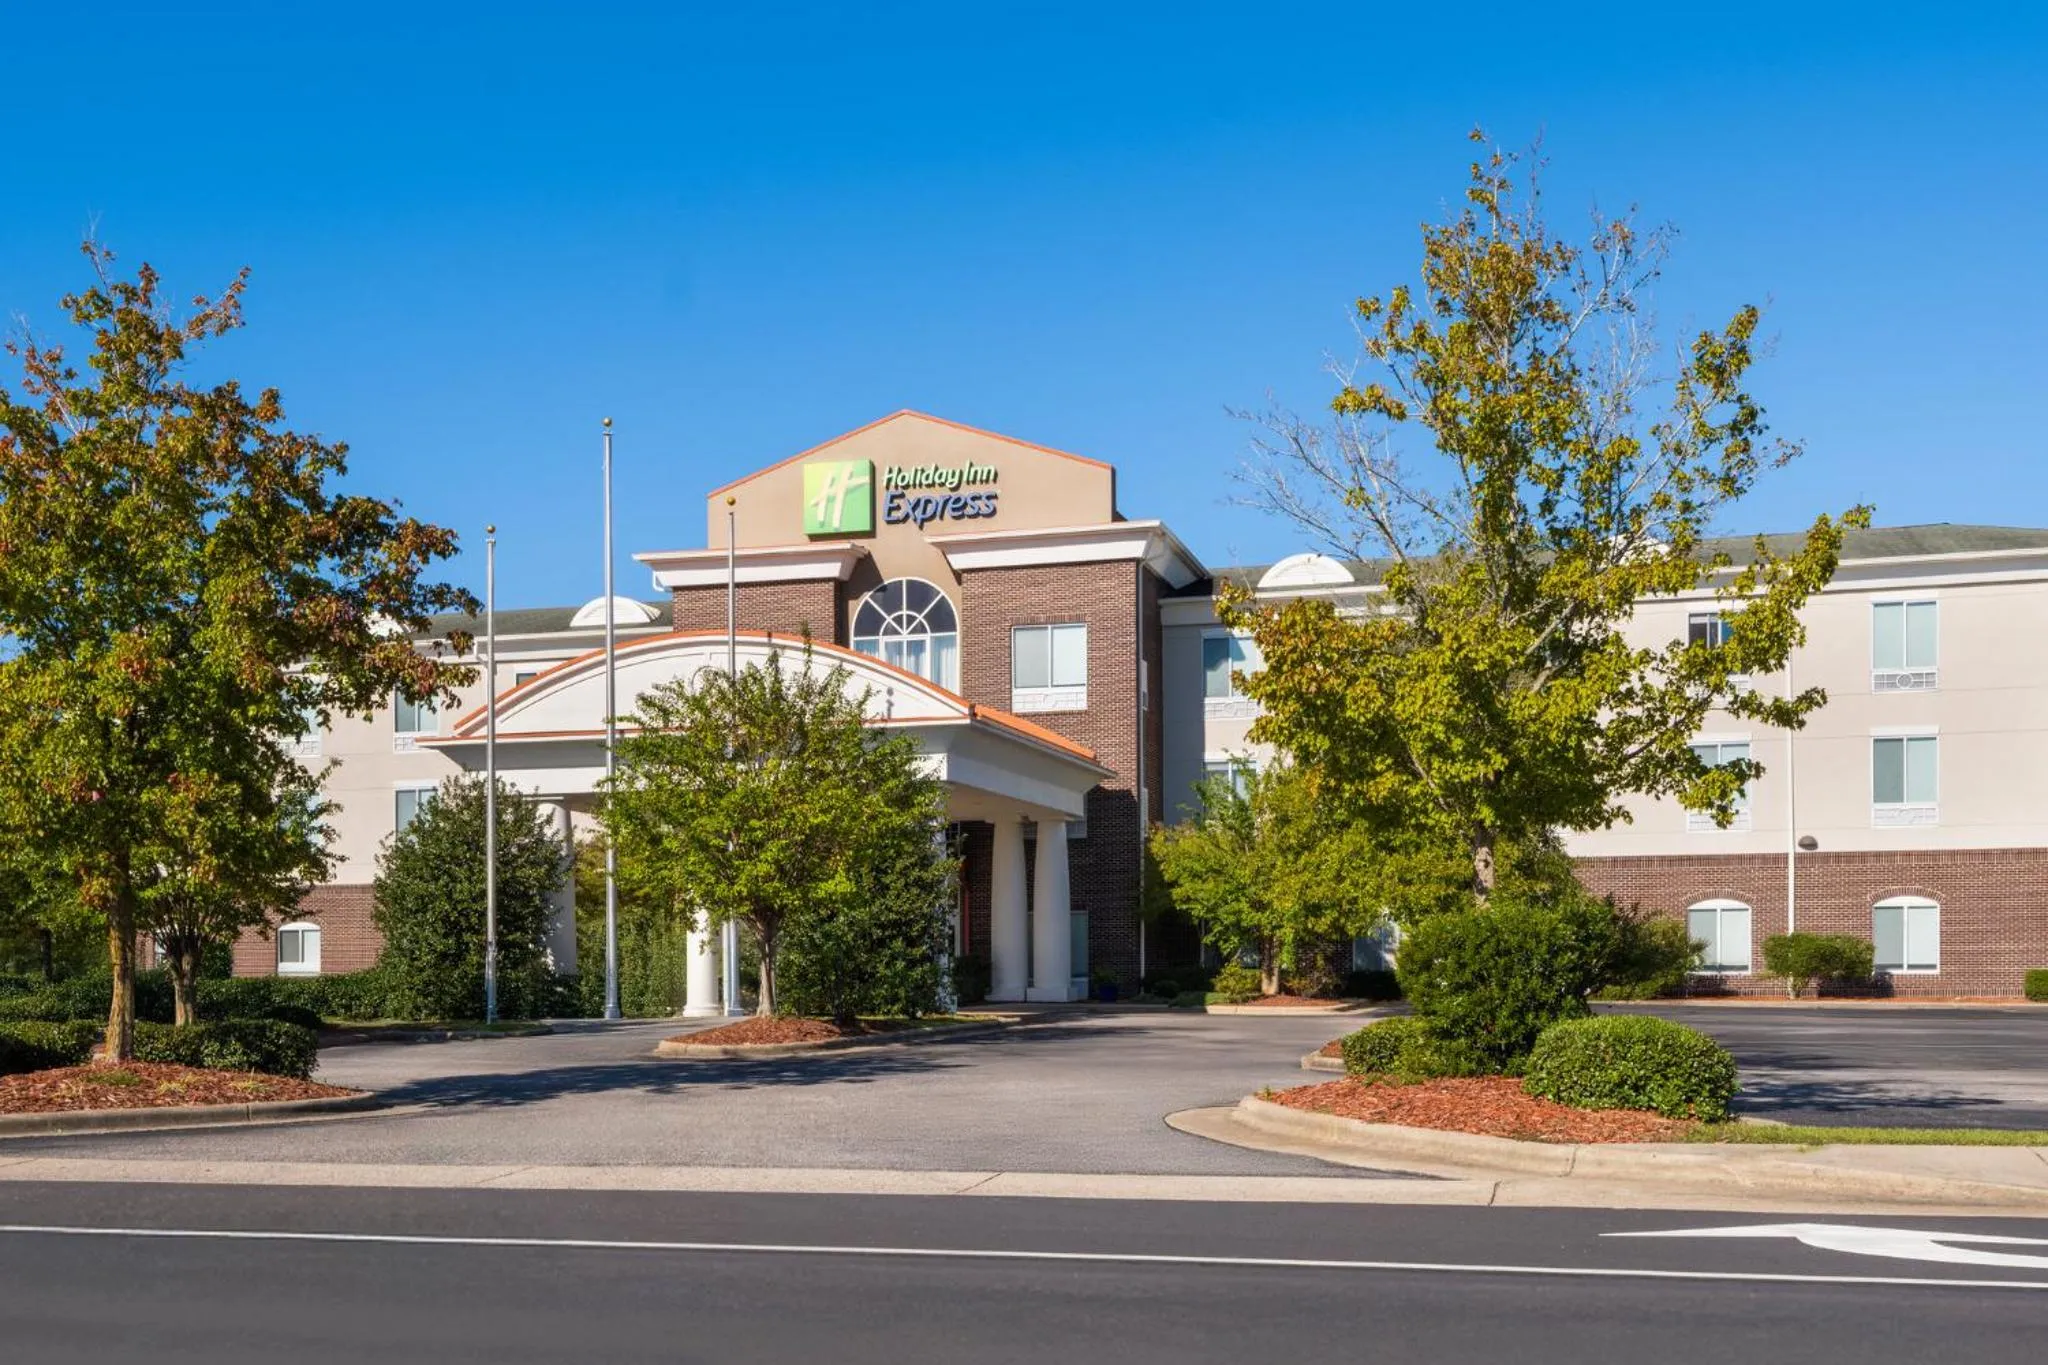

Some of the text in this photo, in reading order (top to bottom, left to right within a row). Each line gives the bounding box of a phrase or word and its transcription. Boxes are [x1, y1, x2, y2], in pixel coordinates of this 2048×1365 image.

[883, 459, 998, 490] Holiday Inn
[883, 490, 998, 530] Express
